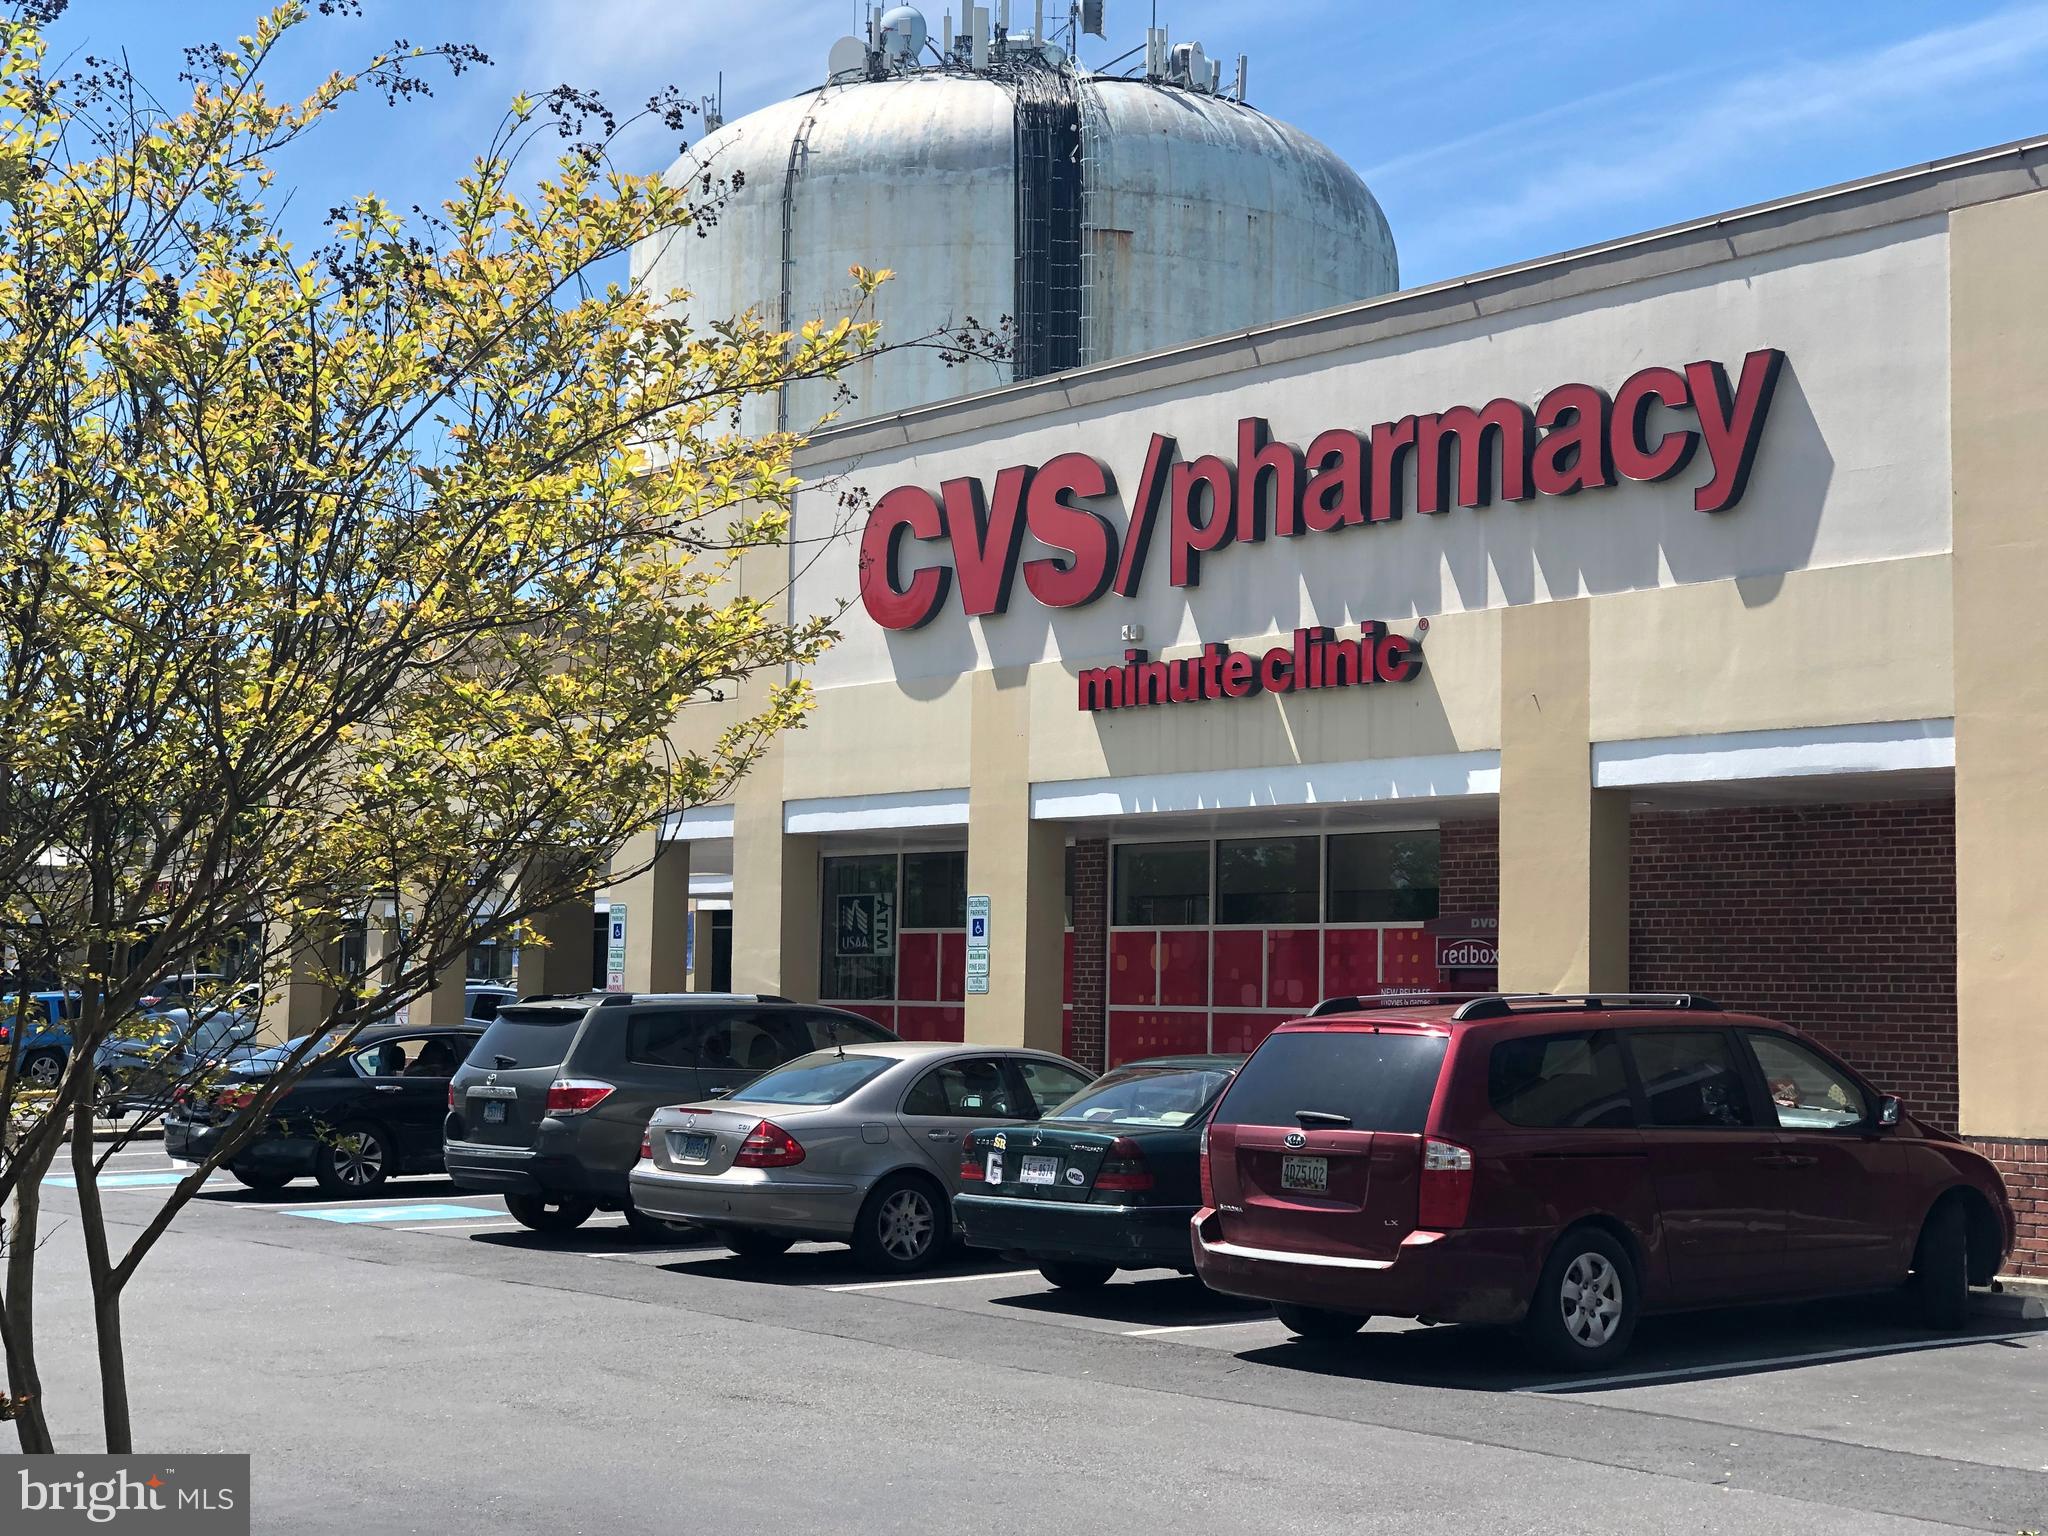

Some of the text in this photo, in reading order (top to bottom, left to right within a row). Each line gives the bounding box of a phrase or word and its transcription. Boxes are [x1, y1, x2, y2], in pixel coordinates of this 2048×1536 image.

[1471, 918, 1497, 928] DVD
[842, 935, 869, 950] USAA
[1442, 945, 1499, 963] redbox
